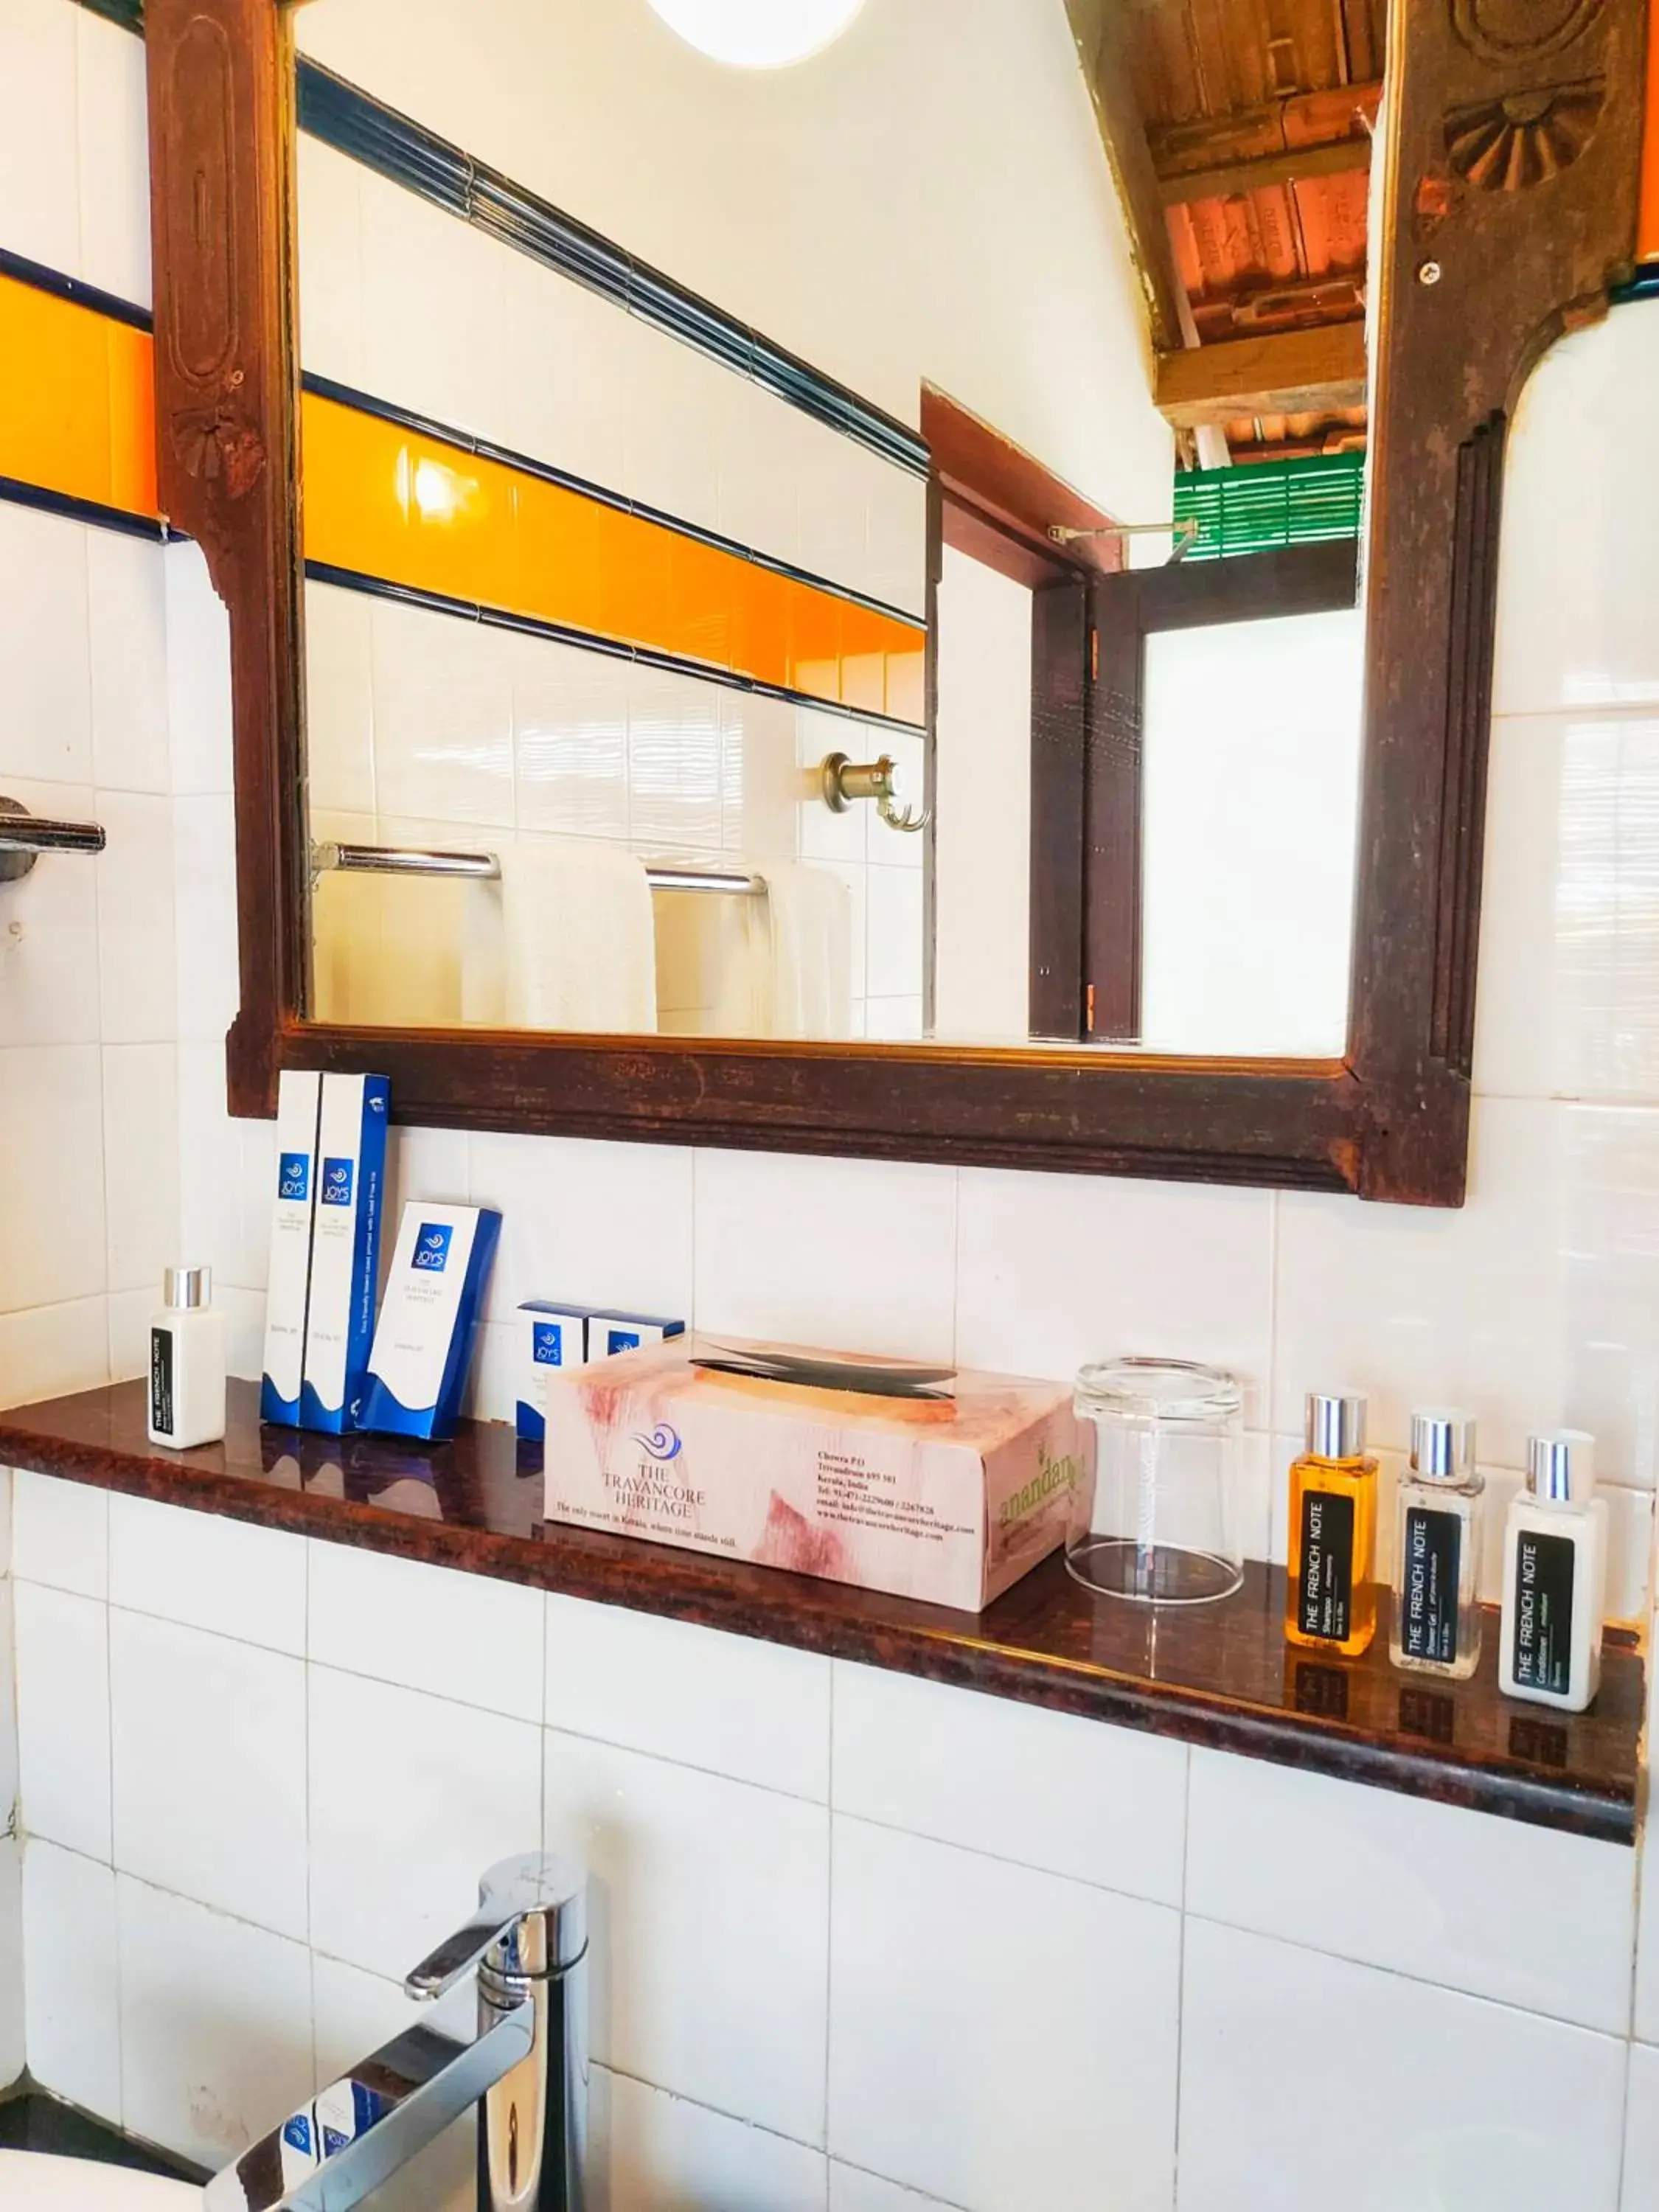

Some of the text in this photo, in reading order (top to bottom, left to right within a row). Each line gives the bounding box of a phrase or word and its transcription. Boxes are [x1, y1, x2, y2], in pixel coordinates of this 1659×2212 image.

[602, 1472, 706, 1506] TRAVANCORE
[639, 1464, 669, 1482] THE
[847, 1478, 869, 1490] India
[616, 1490, 692, 1519] HERITAGE
[1306, 1502, 1323, 1629] THE FRENCH NOTE
[1409, 1519, 1427, 1651] THE FRENCH NOTE
[1518, 1543, 1537, 1680] THE FRENCH NOTE
[1536, 1636, 1548, 1684] Conditioner
